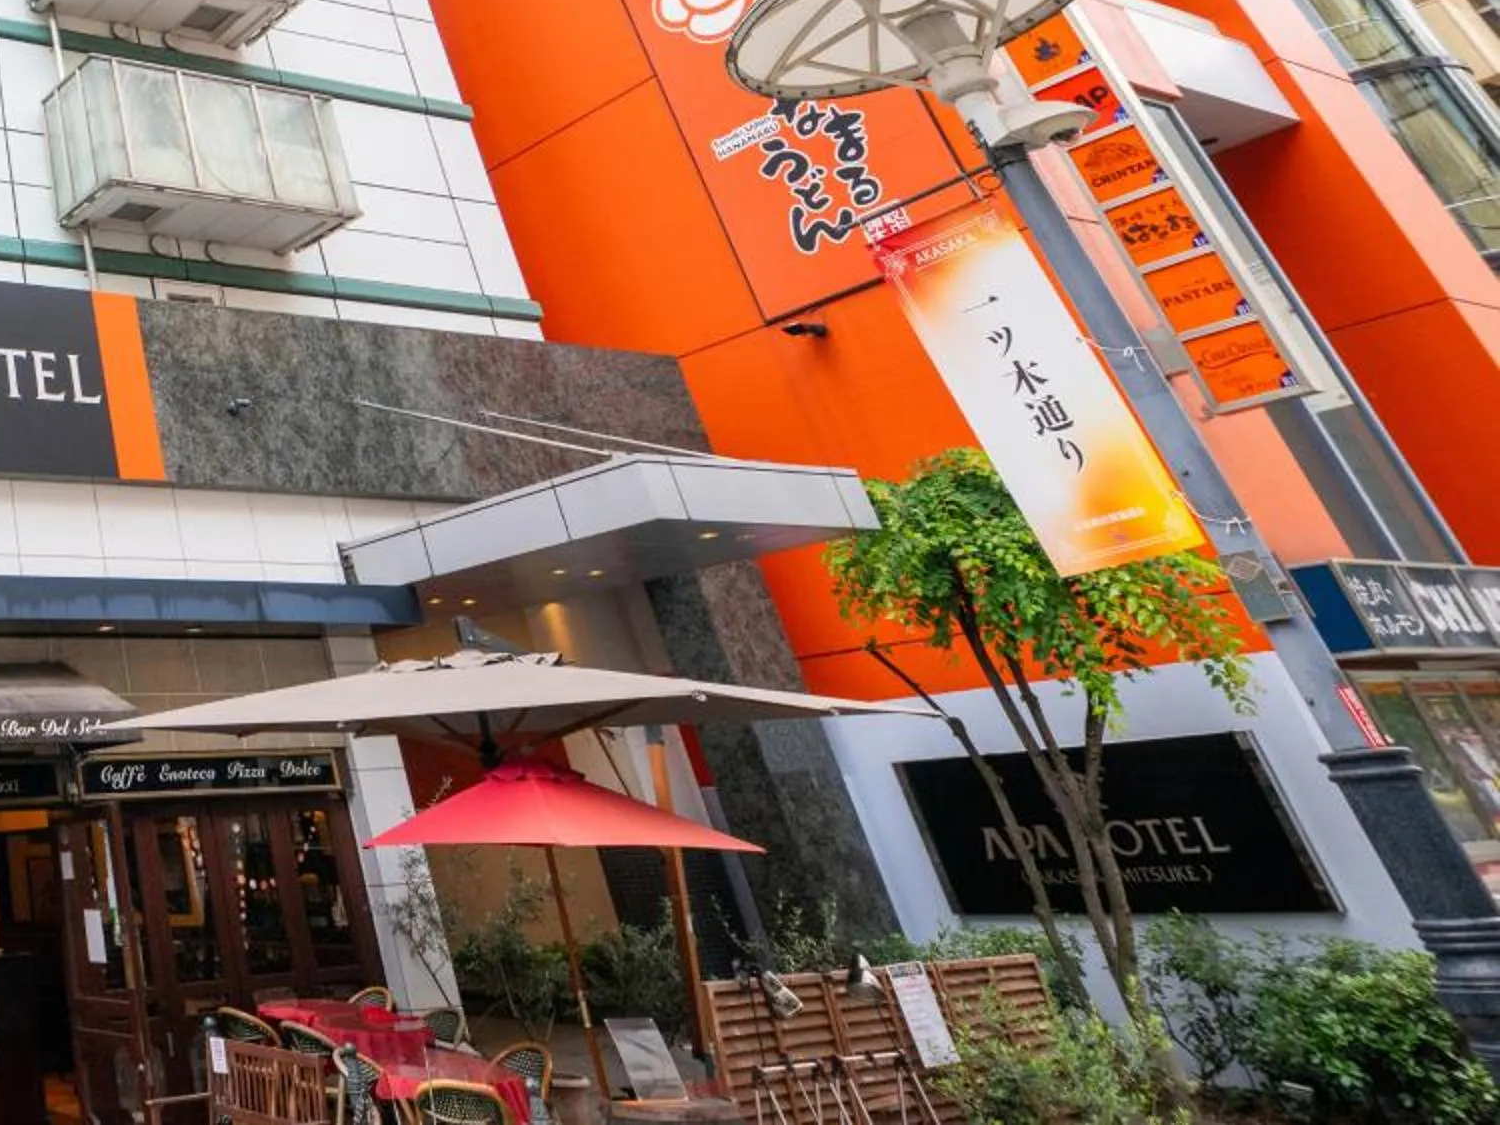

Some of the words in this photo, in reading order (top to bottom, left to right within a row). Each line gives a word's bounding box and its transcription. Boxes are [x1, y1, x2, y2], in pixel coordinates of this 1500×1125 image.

[760, 138, 854, 253] うどん
[915, 232, 978, 266] AKASAKA
[961, 293, 1086, 474] 一ツ木通り
[0, 718, 36, 736] Bar
[158, 762, 217, 783] Enoteca
[226, 761, 266, 780] Pizza
[278, 759, 322, 779] Dolce
[1086, 816, 1232, 858] OTEL
